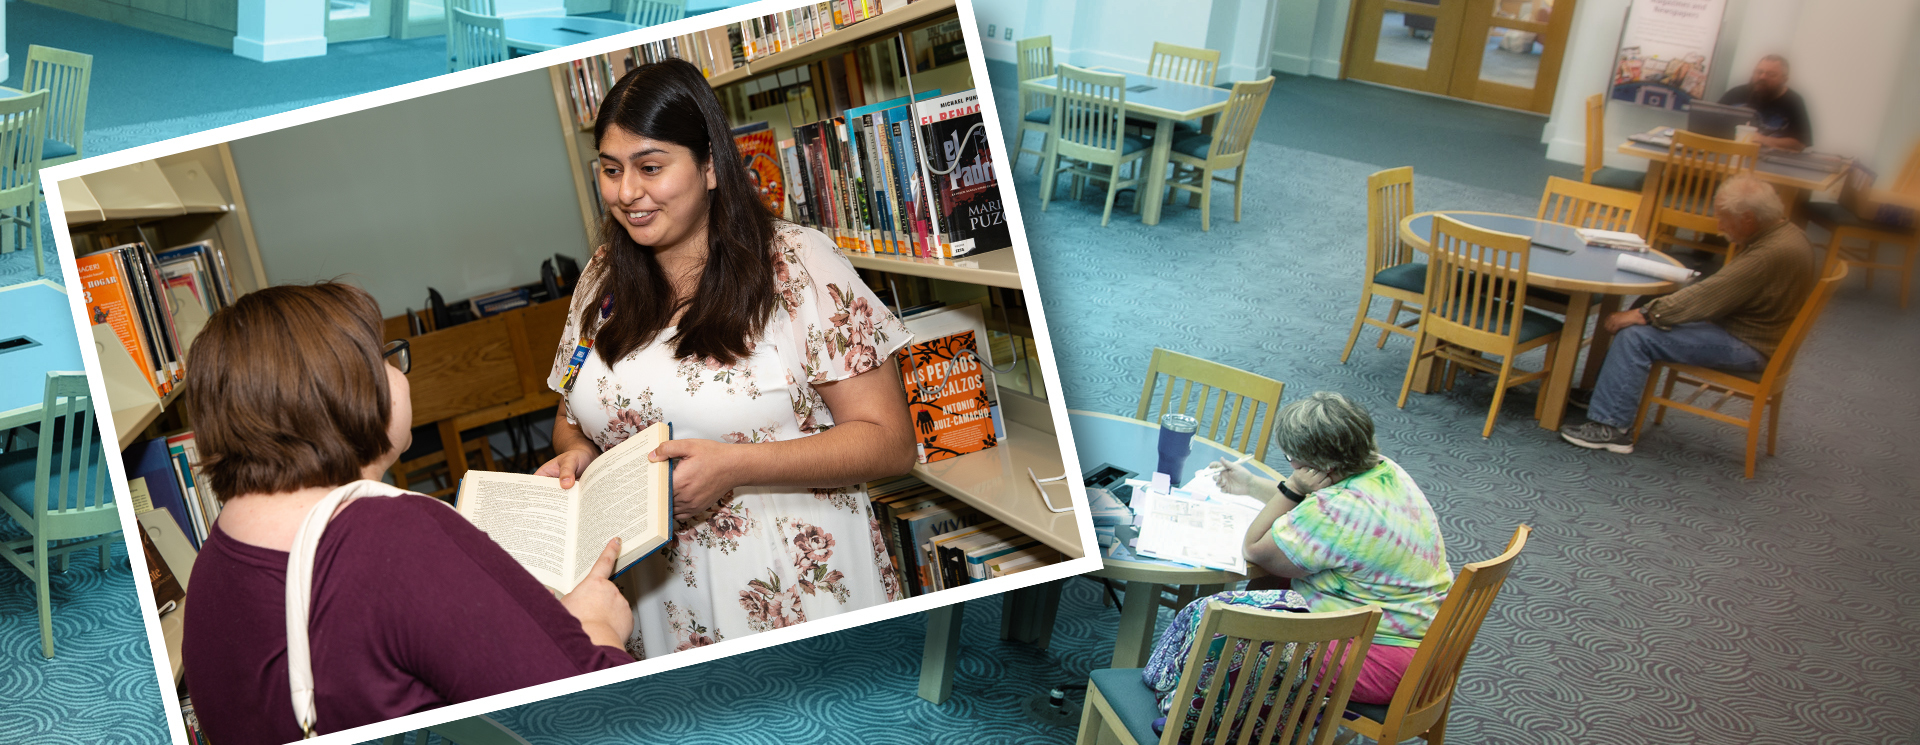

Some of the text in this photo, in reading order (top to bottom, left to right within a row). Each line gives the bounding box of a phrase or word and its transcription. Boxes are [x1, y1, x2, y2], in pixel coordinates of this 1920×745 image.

[940, 99, 964, 108] MICHAEL
[943, 129, 960, 161] el
[87, 276, 118, 289] HOGAR
[905, 354, 978, 386] LOS PERROS
[919, 373, 983, 403] DESCALZOS
[933, 407, 989, 431] RUIZ-CAMACHO
[942, 398, 975, 416] ANTONIO
